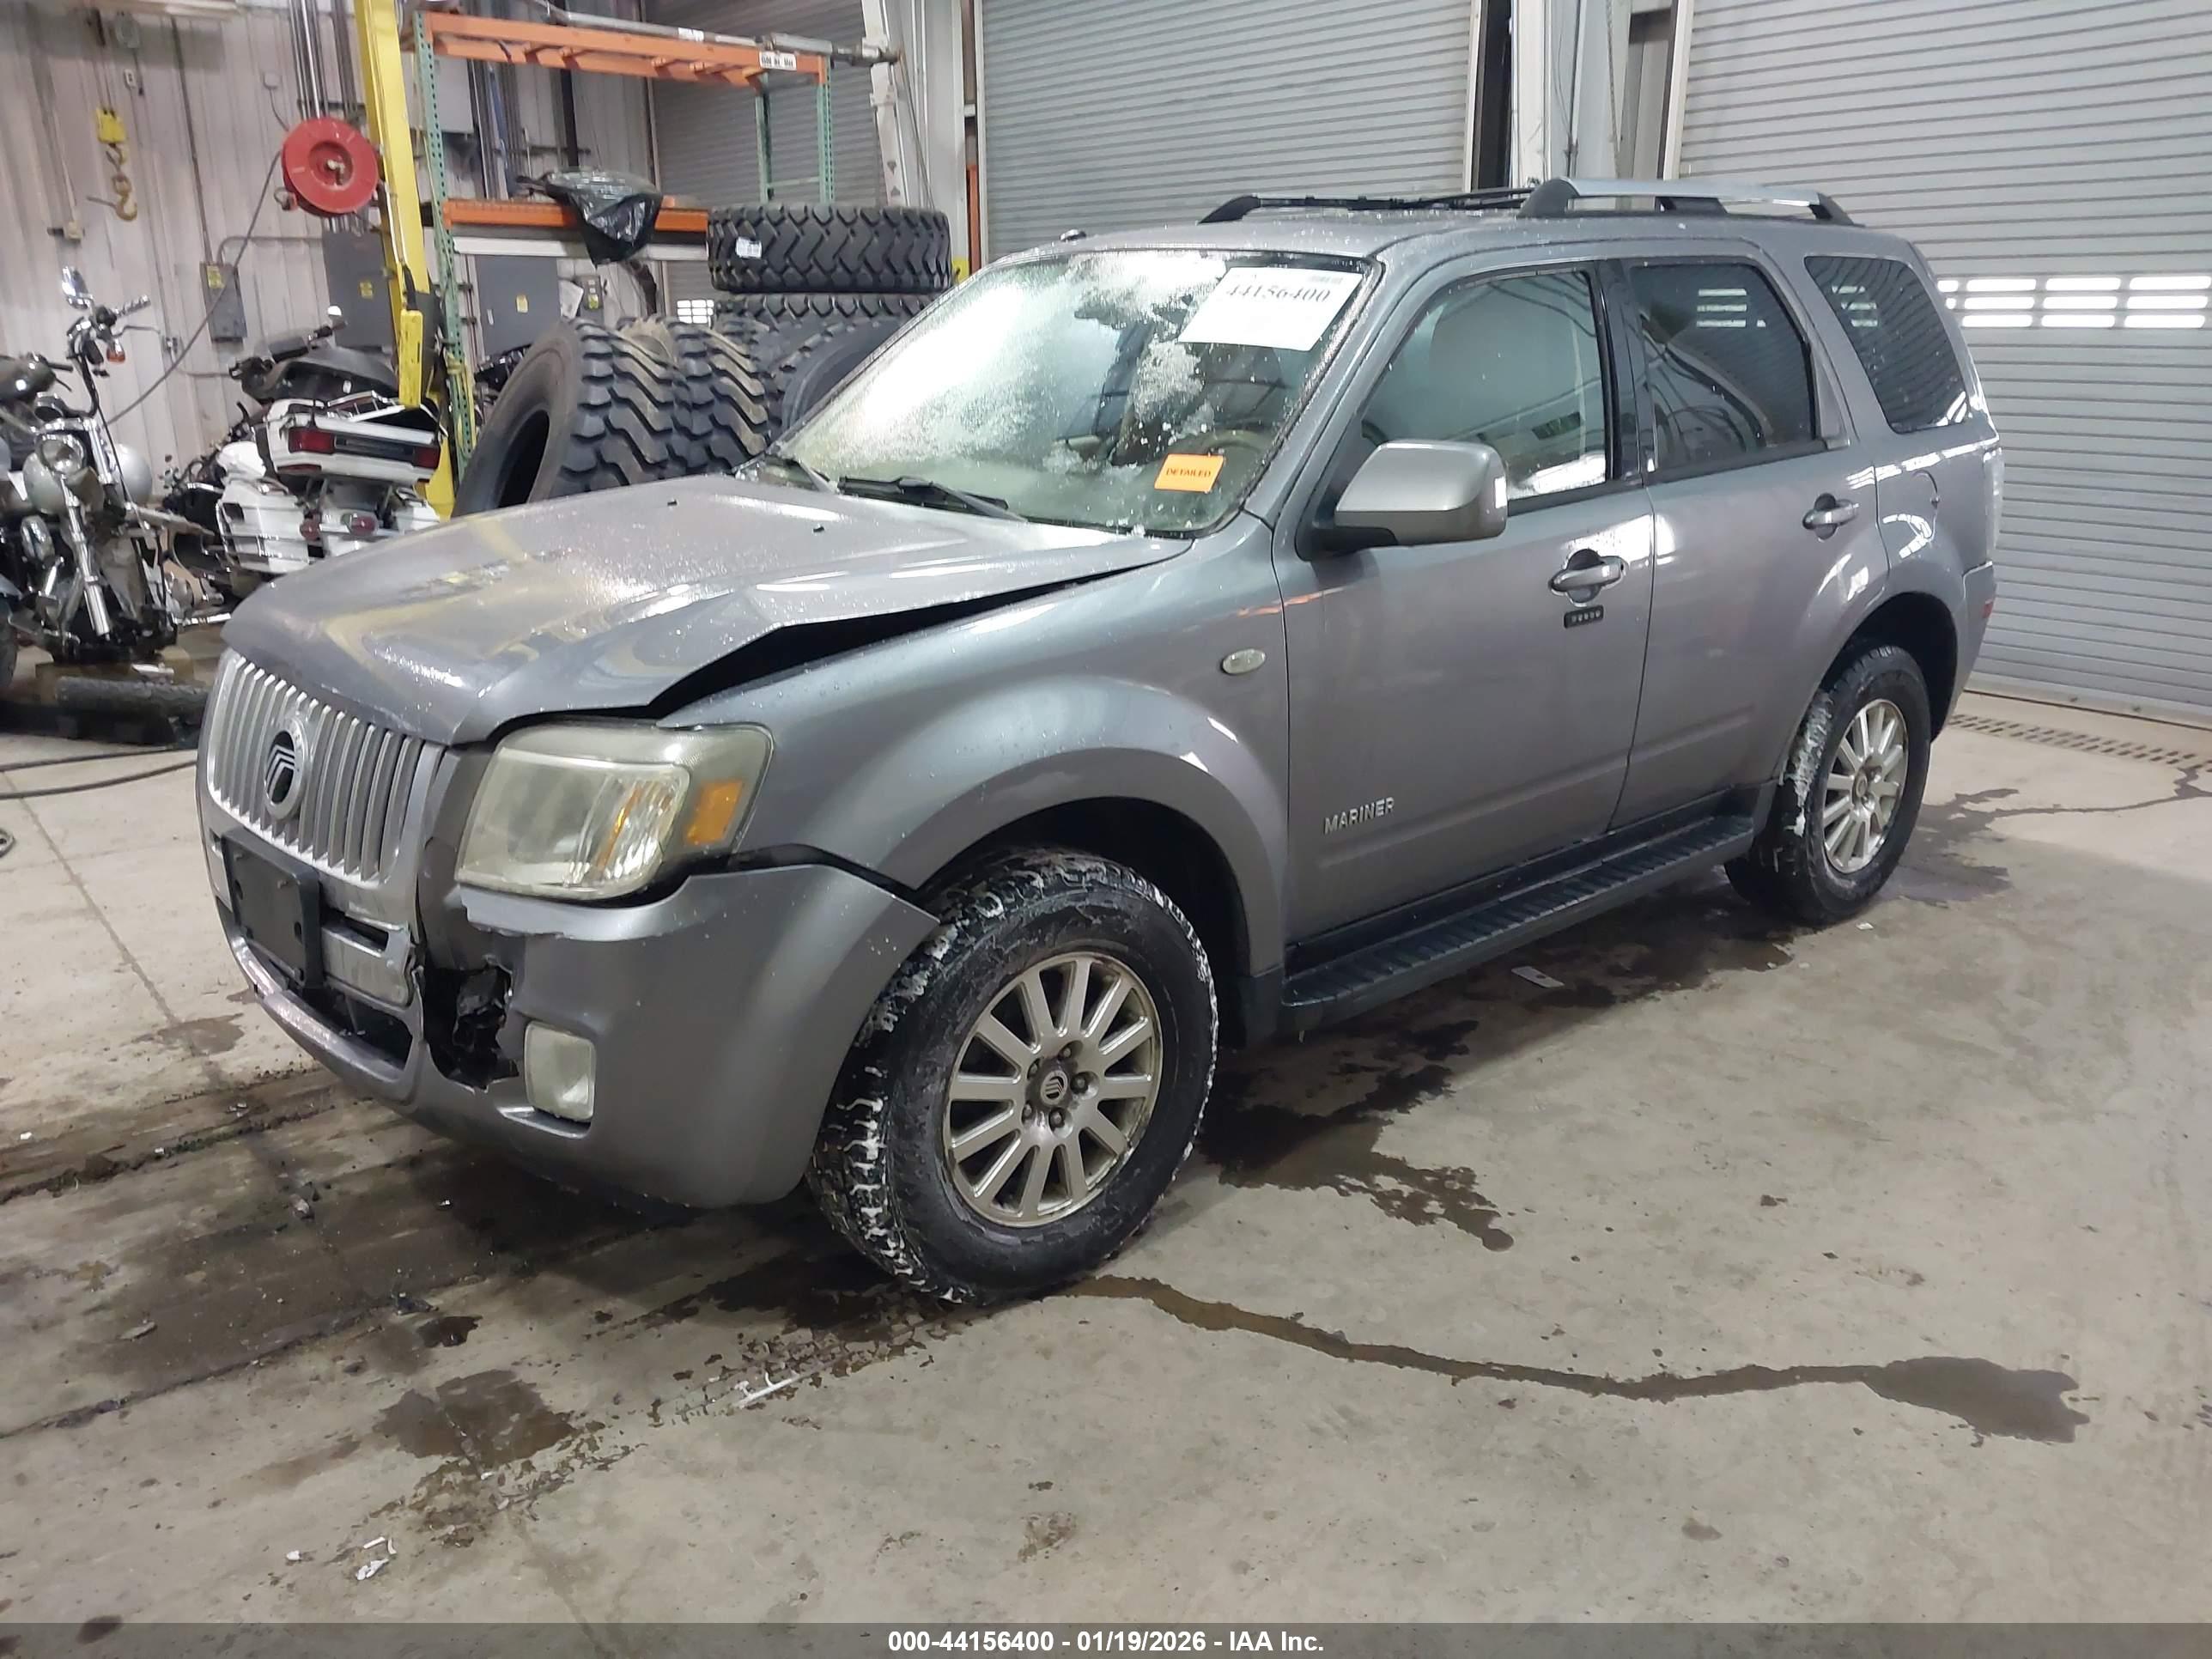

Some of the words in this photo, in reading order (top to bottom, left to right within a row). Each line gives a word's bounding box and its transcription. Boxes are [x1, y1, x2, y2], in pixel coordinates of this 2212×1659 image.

[1226, 284, 1331, 301] 44156400
[1165, 467, 1212, 477] DETAILED
[1323, 796, 1395, 835] MARINER
